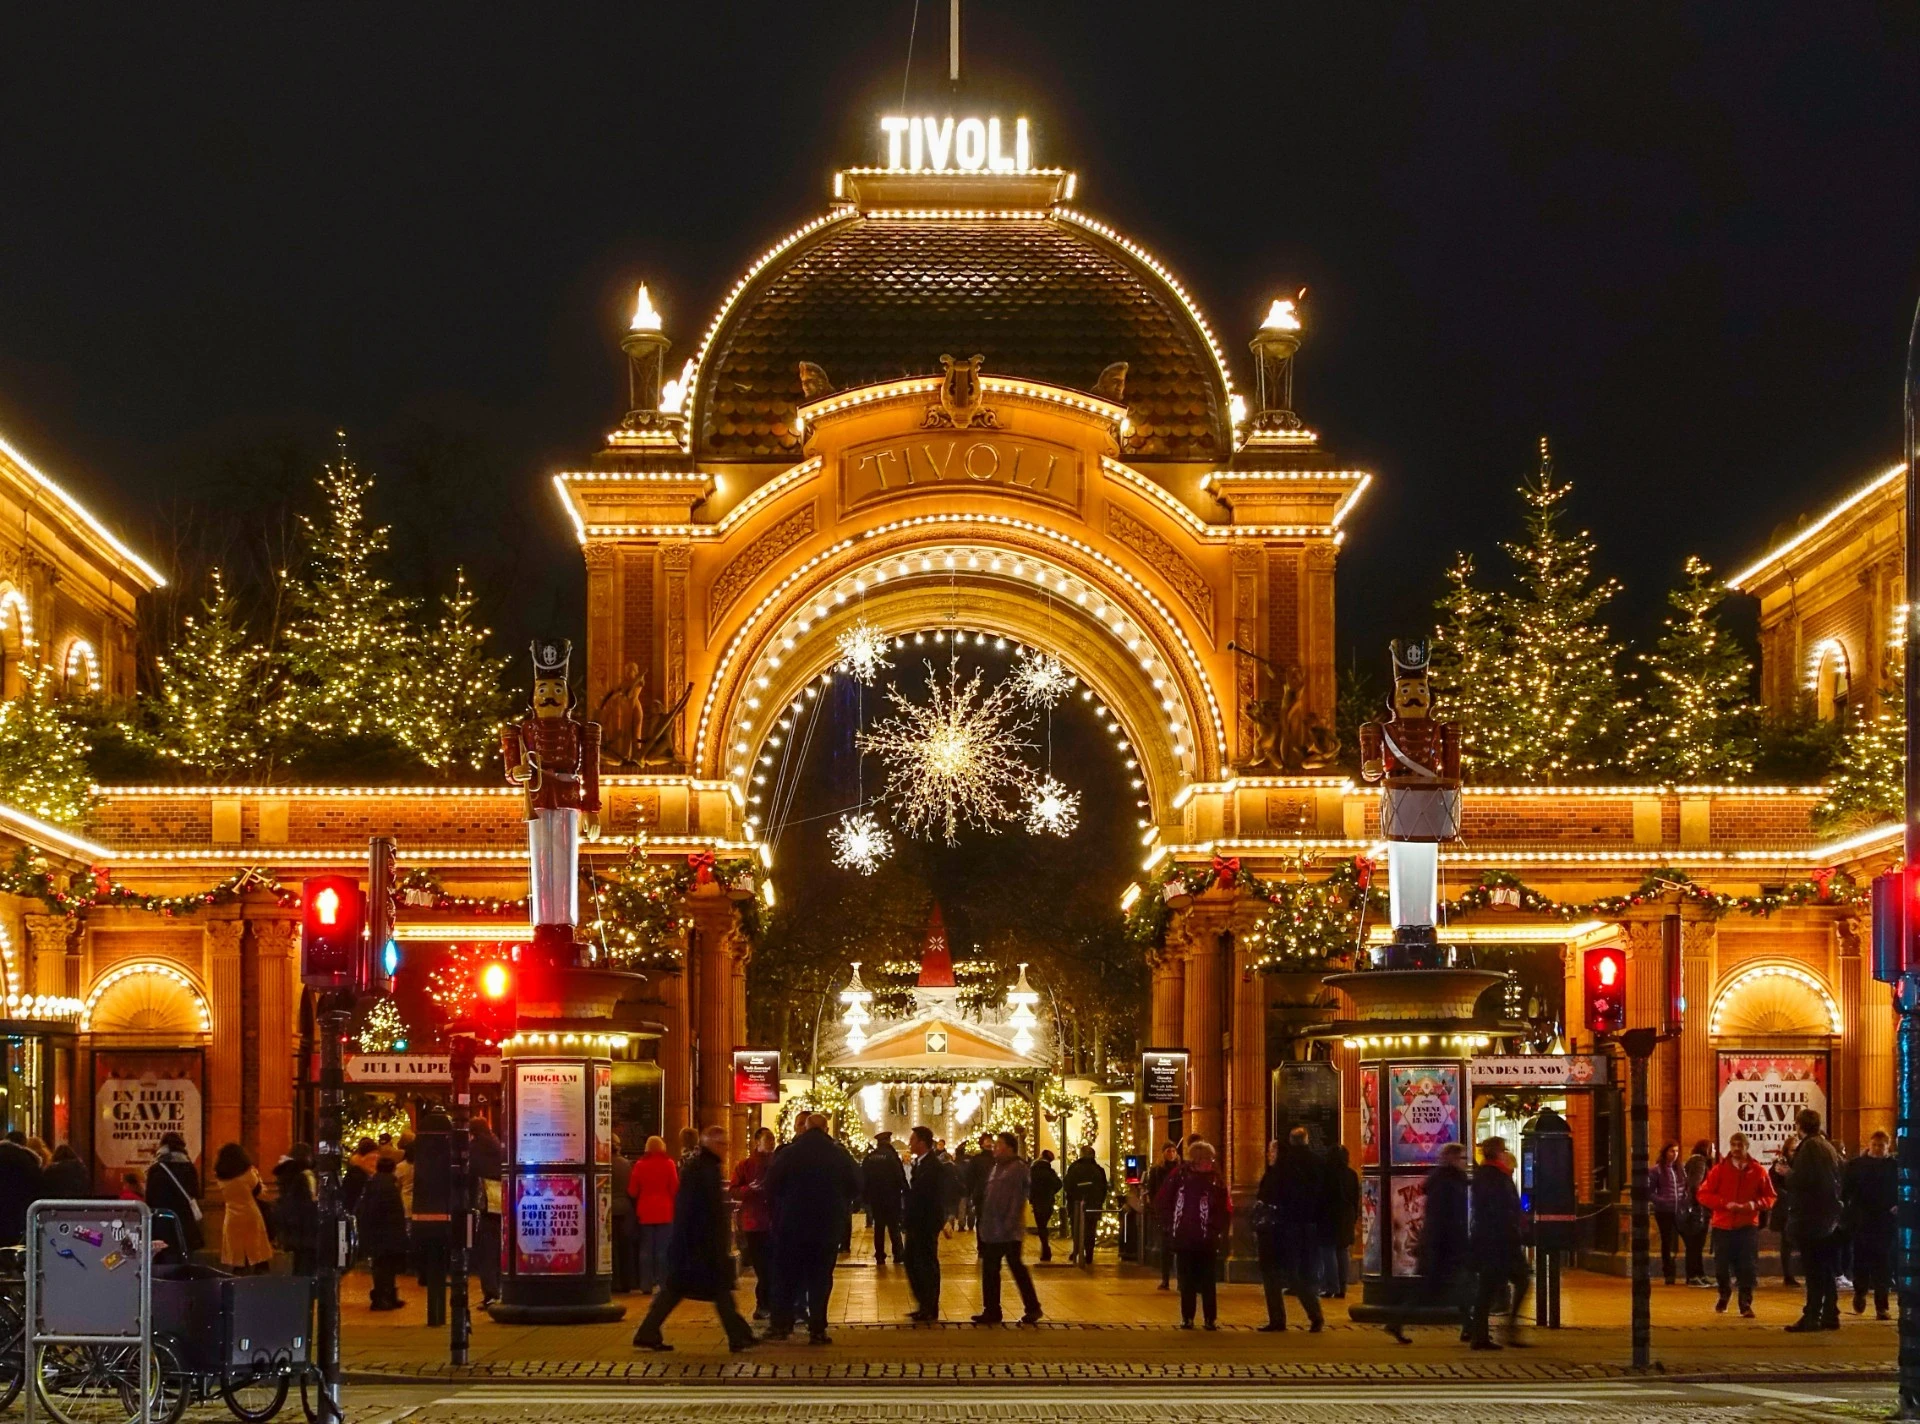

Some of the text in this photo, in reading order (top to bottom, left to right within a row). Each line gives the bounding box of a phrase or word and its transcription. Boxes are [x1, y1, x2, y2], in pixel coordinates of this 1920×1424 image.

[881, 117, 1029, 170] TIVOLI
[859, 442, 1059, 490] TIVOLI
[361, 1062, 492, 1074] JUL I ALPEND
[1540, 1066, 1564, 1075] NOV.
[523, 1074, 577, 1082] PROGRAM
[113, 1091, 185, 1101] EN LILLE
[1738, 1092, 1809, 1103] EN LILLE
[113, 1103, 185, 1121] GAVE
[114, 1122, 185, 1131] MED STORE
[1738, 1123, 1765, 1132] MED
[550, 1211, 579, 1220] 2015
[550, 1228, 579, 1236] MED
